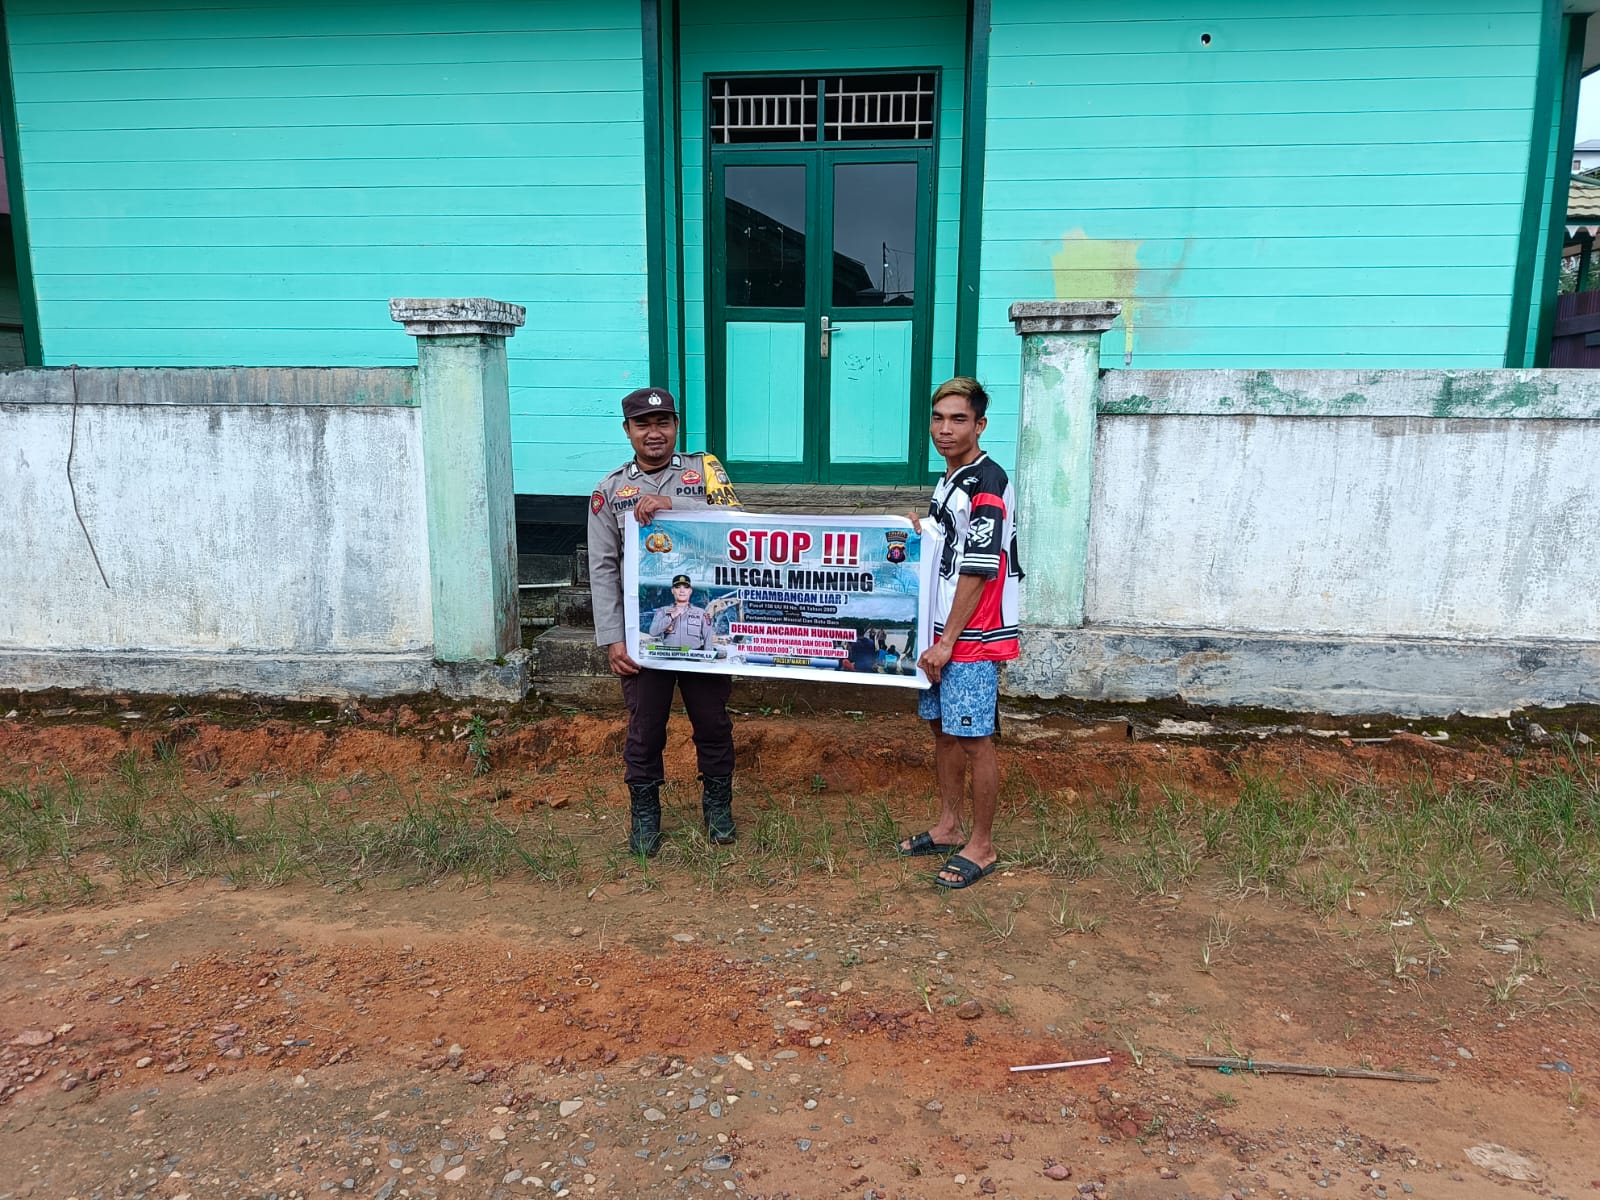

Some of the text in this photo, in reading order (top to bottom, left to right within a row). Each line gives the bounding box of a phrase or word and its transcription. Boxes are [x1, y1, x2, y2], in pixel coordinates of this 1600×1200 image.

[728, 529, 858, 565] STOP !!!
[714, 566, 873, 592] ILLEGAL MINNING
[744, 590, 817, 604] PENAMBANGAN
[819, 593, 841, 604] LIAR
[731, 624, 855, 640] DENGAN ANCAMAN HUKUMAN
